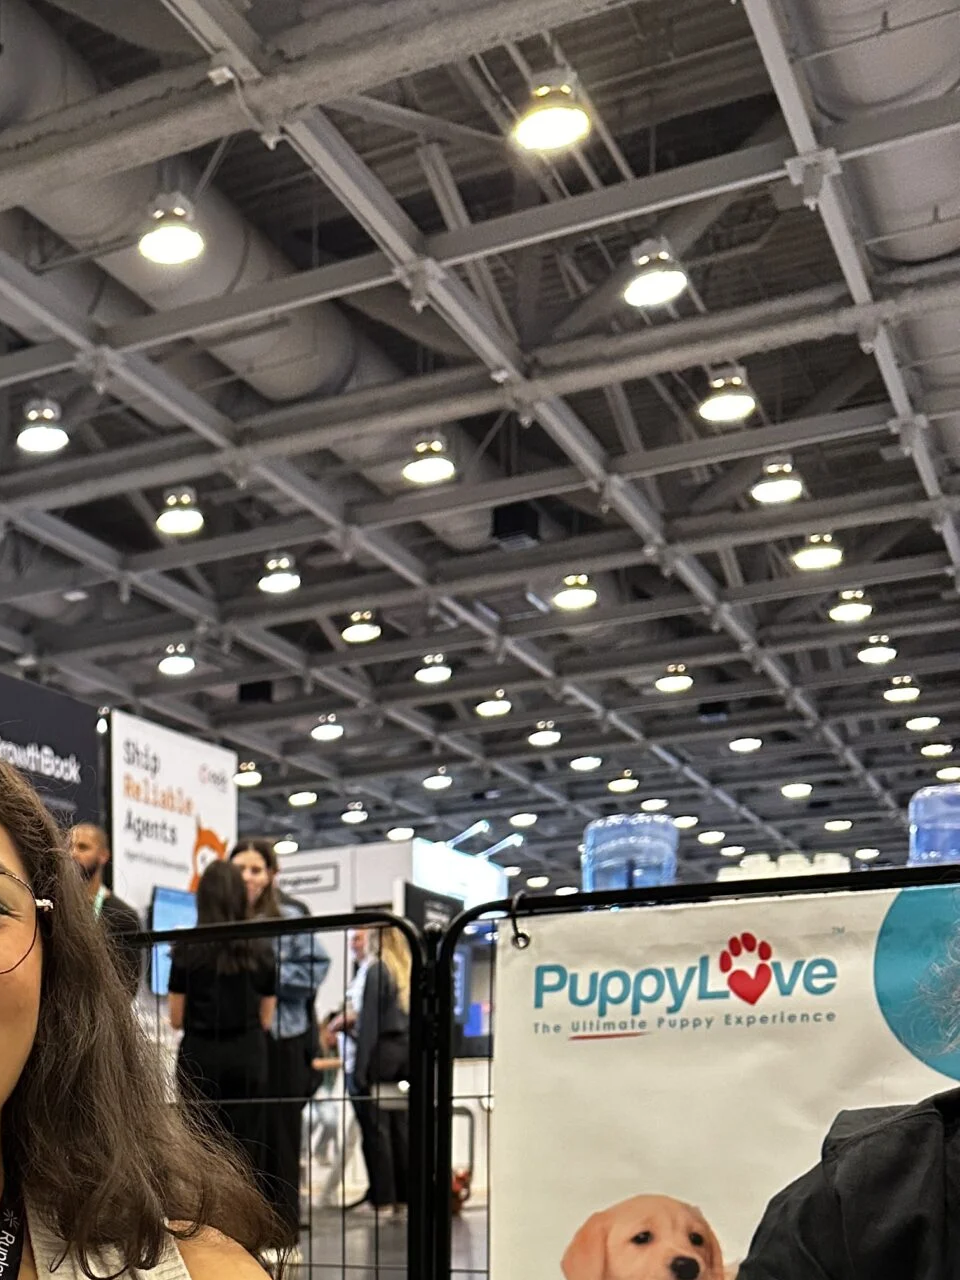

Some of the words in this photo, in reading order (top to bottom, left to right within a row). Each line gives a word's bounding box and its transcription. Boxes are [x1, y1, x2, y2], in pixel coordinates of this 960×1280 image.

[123, 739, 160, 778] Ship
[123, 773, 193, 816] Reliable
[124, 808, 177, 845] Agents
[533, 1022, 562, 1034] The
[571, 1018, 648, 1033] Ultimate
[657, 1015, 714, 1030] Puppy
[724, 1010, 837, 1027] Experience
